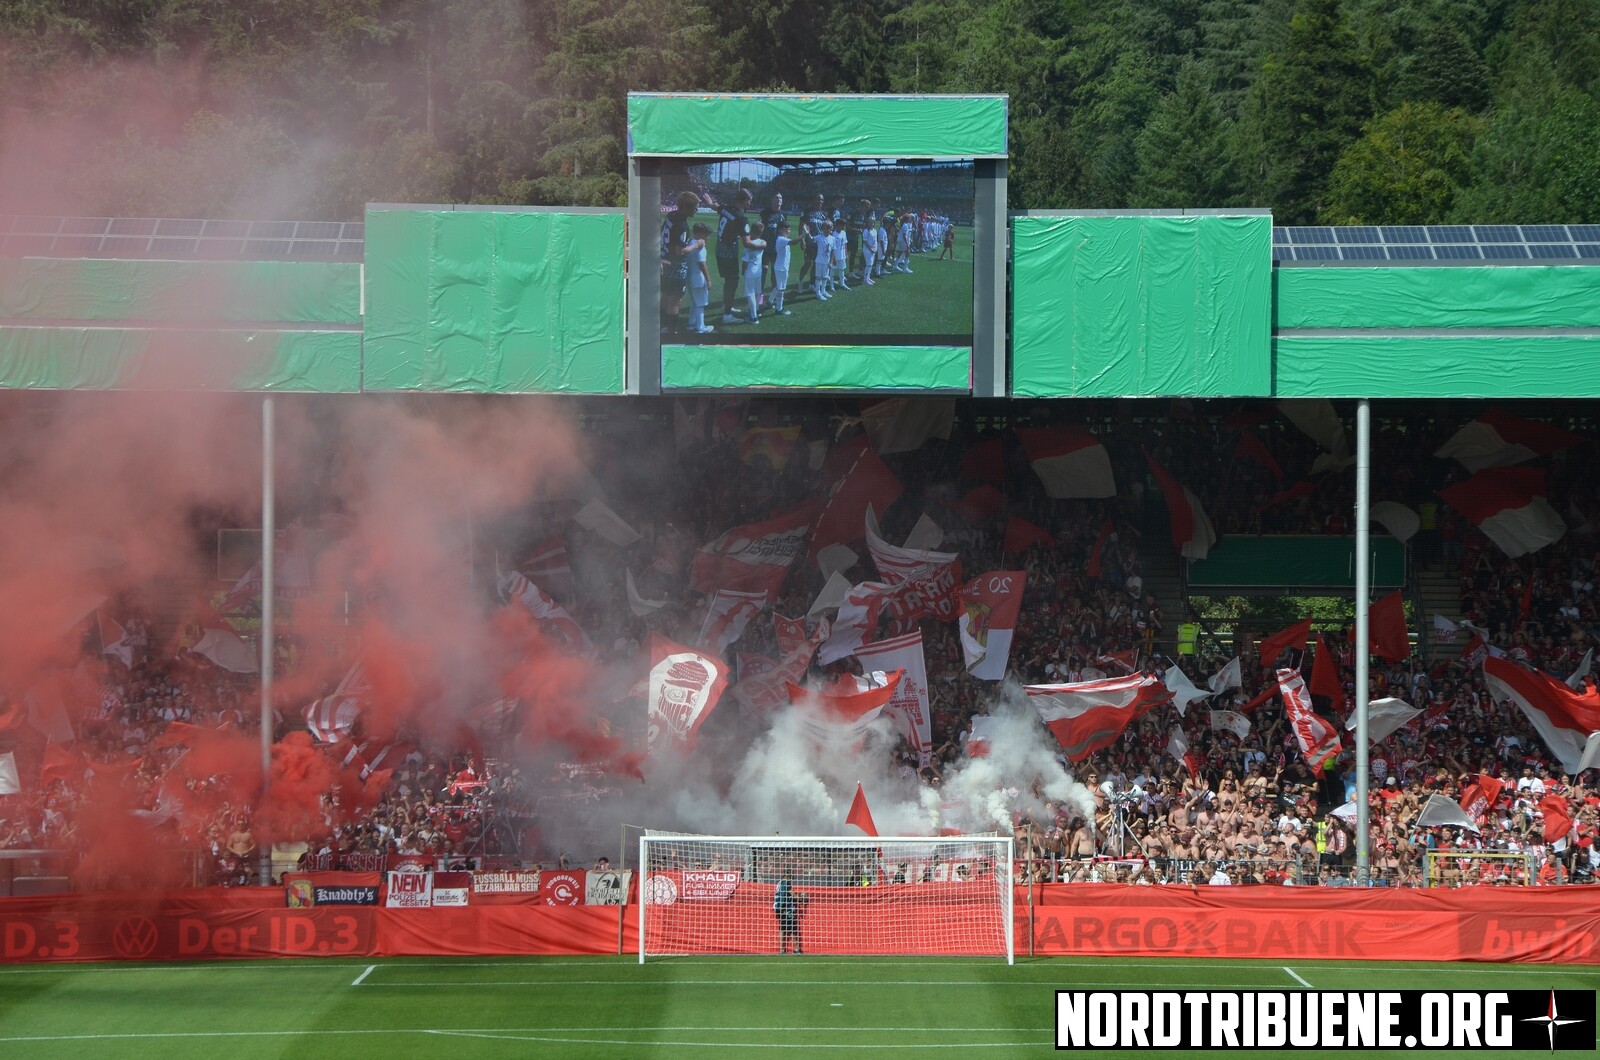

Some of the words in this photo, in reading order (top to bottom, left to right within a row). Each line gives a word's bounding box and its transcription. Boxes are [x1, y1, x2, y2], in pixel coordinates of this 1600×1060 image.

[306, 854, 333, 870] STOP
[392, 874, 427, 893] NEIN
[473, 872, 515, 883] FUSSBALL
[516, 873, 539, 883] MUSS
[545, 874, 580, 889] VIDEOBEWEIS
[474, 882, 520, 893] BEZAHLBAR
[521, 882, 538, 892] SEIN
[317, 888, 374, 903] Knaddly's
[178, 919, 257, 953] Der
[269, 915, 358, 953] ID.3
[1481, 919, 1594, 957] bwin
